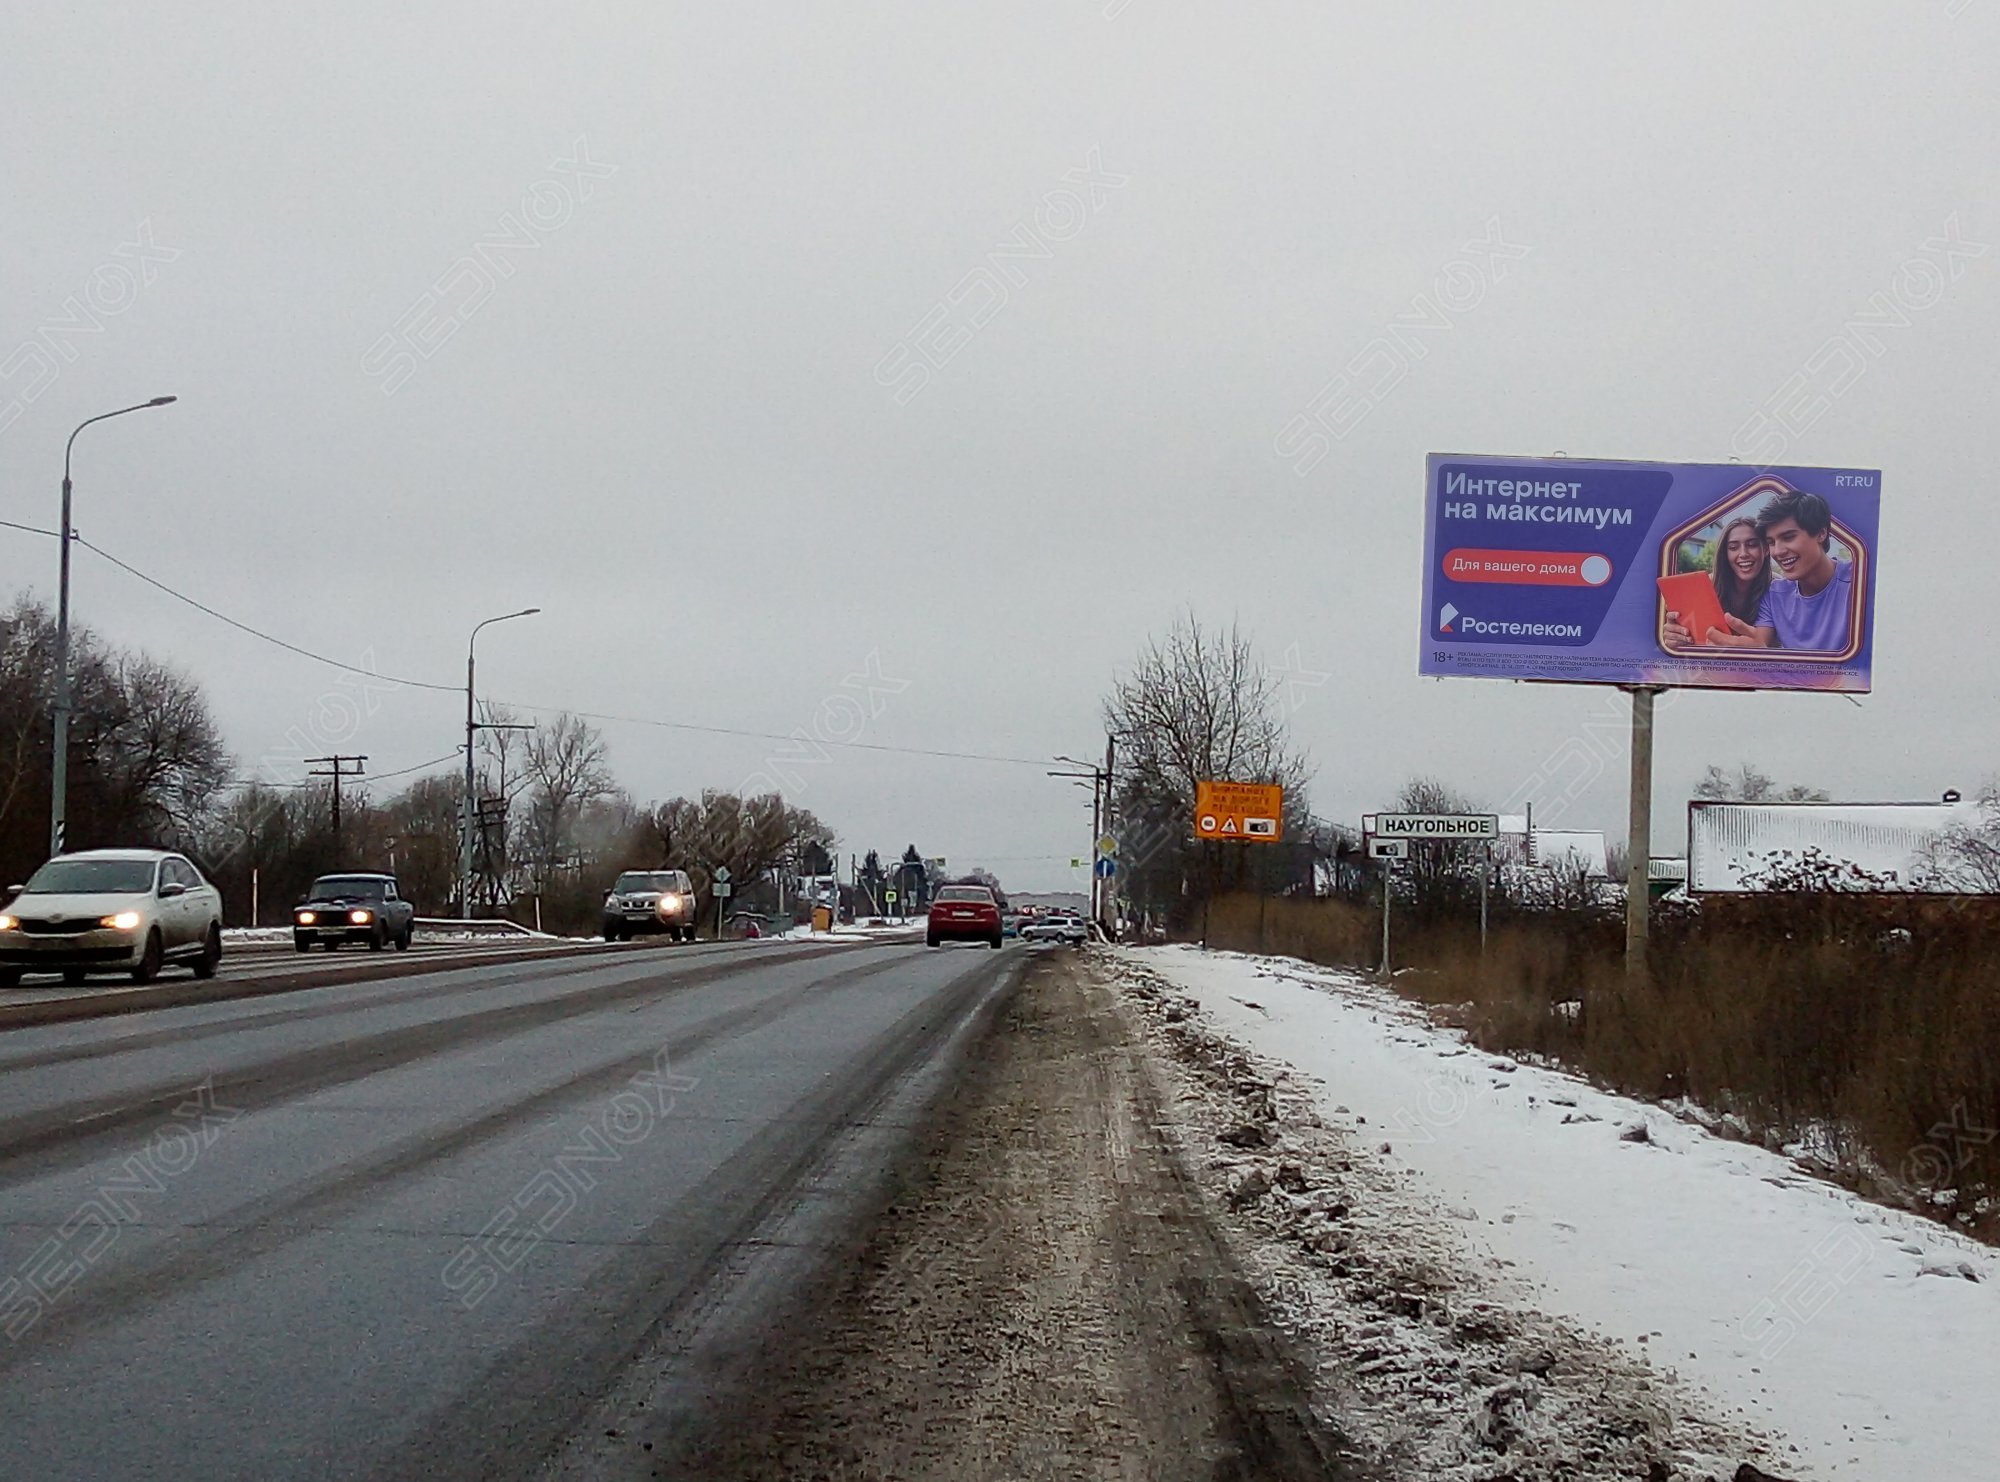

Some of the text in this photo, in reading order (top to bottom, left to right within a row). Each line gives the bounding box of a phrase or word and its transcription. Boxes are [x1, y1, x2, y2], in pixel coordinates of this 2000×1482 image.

[1446, 472, 1582, 501] Интернет
[1836, 476, 1873, 488] RT.RU
[1445, 501, 1632, 529] на максимум
[1453, 558, 1576, 574] Для вашего дома
[1462, 617, 1581, 637] Ростелеком
[1433, 652, 1454, 663] 18+
[1385, 818, 1491, 834] НАУГОЛЬНОЕ
